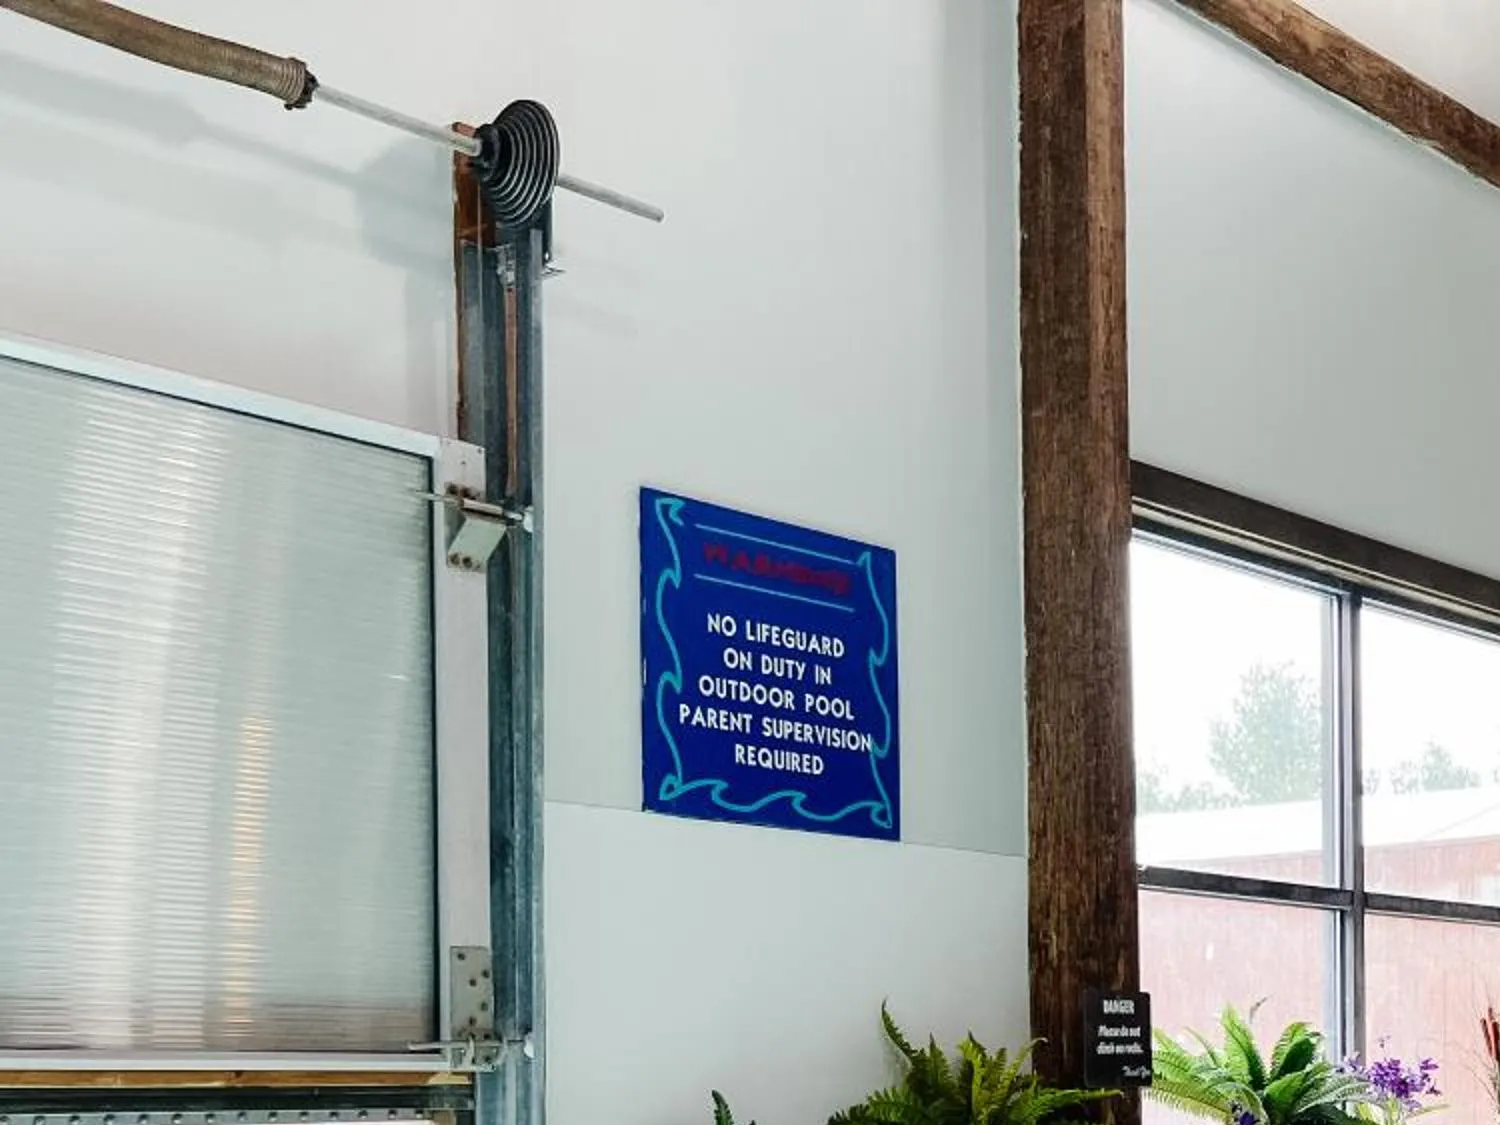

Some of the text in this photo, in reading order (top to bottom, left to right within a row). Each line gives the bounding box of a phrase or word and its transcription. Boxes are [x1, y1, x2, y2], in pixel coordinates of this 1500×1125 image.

[707, 613, 844, 658] NO LIFEGUARD
[723, 647, 832, 685] ON DUTY IN
[698, 675, 855, 721] OUTDOOR POOL
[679, 703, 872, 752] PARENT SUPERVISION
[735, 743, 824, 775] REQUIRED
[1103, 999, 1135, 1014] DANGER
